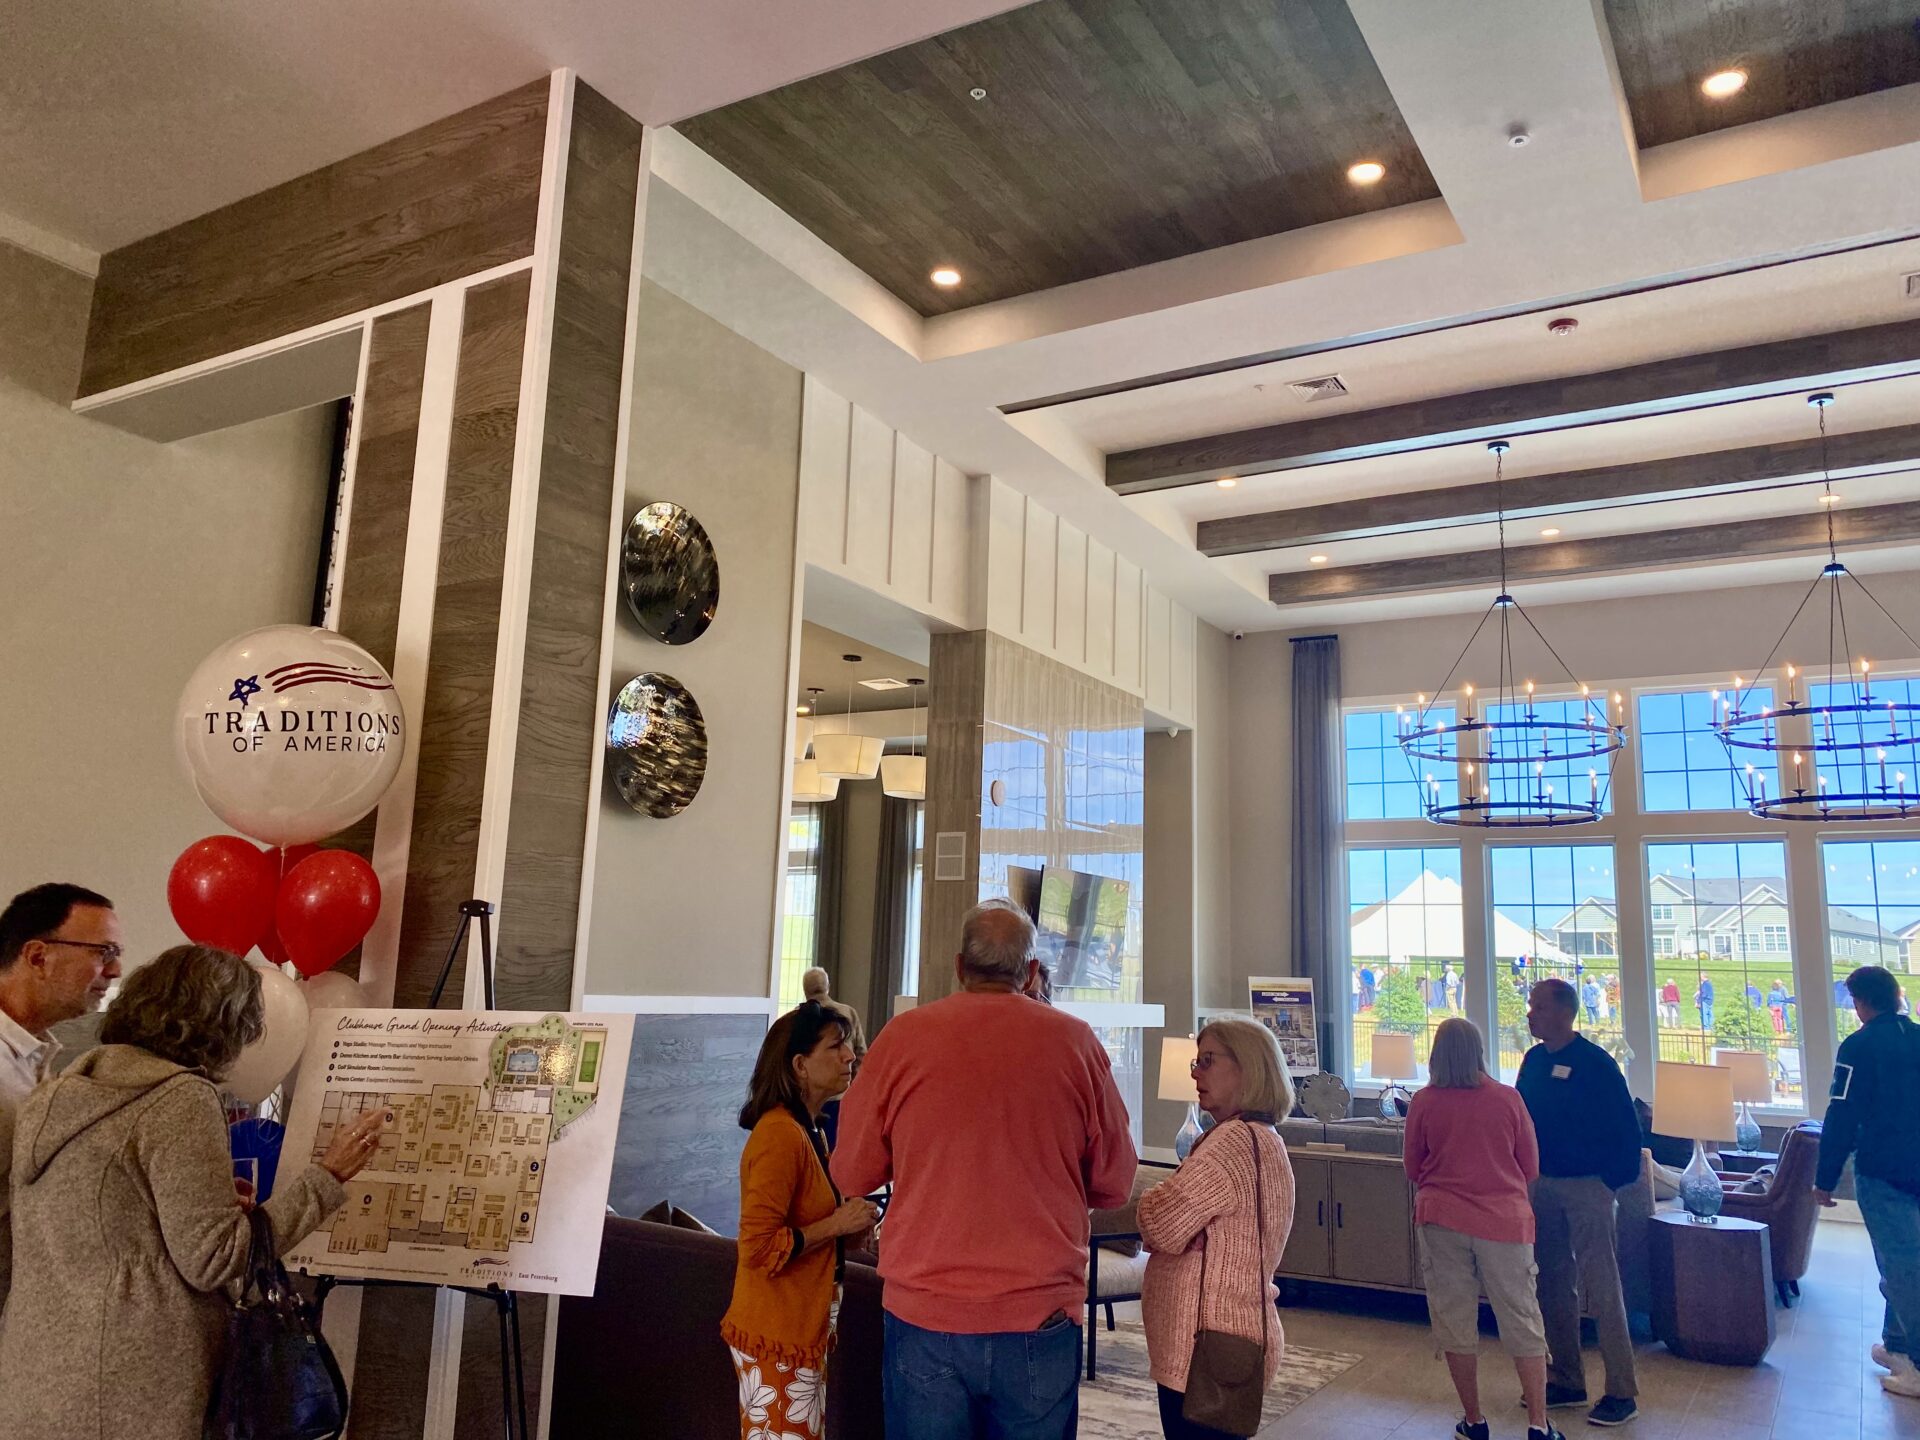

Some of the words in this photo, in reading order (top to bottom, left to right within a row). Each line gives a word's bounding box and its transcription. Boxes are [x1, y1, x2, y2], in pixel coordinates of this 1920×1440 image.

[205, 710, 400, 735] TRADITIONS
[232, 736, 264, 753] OF
[284, 736, 386, 752] AMERICA
[337, 1016, 384, 1030] Clubhouse
[386, 1017, 419, 1034] Grand
[422, 1018, 462, 1038] Opening
[466, 1018, 513, 1034] Activities
[460, 1268, 513, 1277] TRADITIONS
